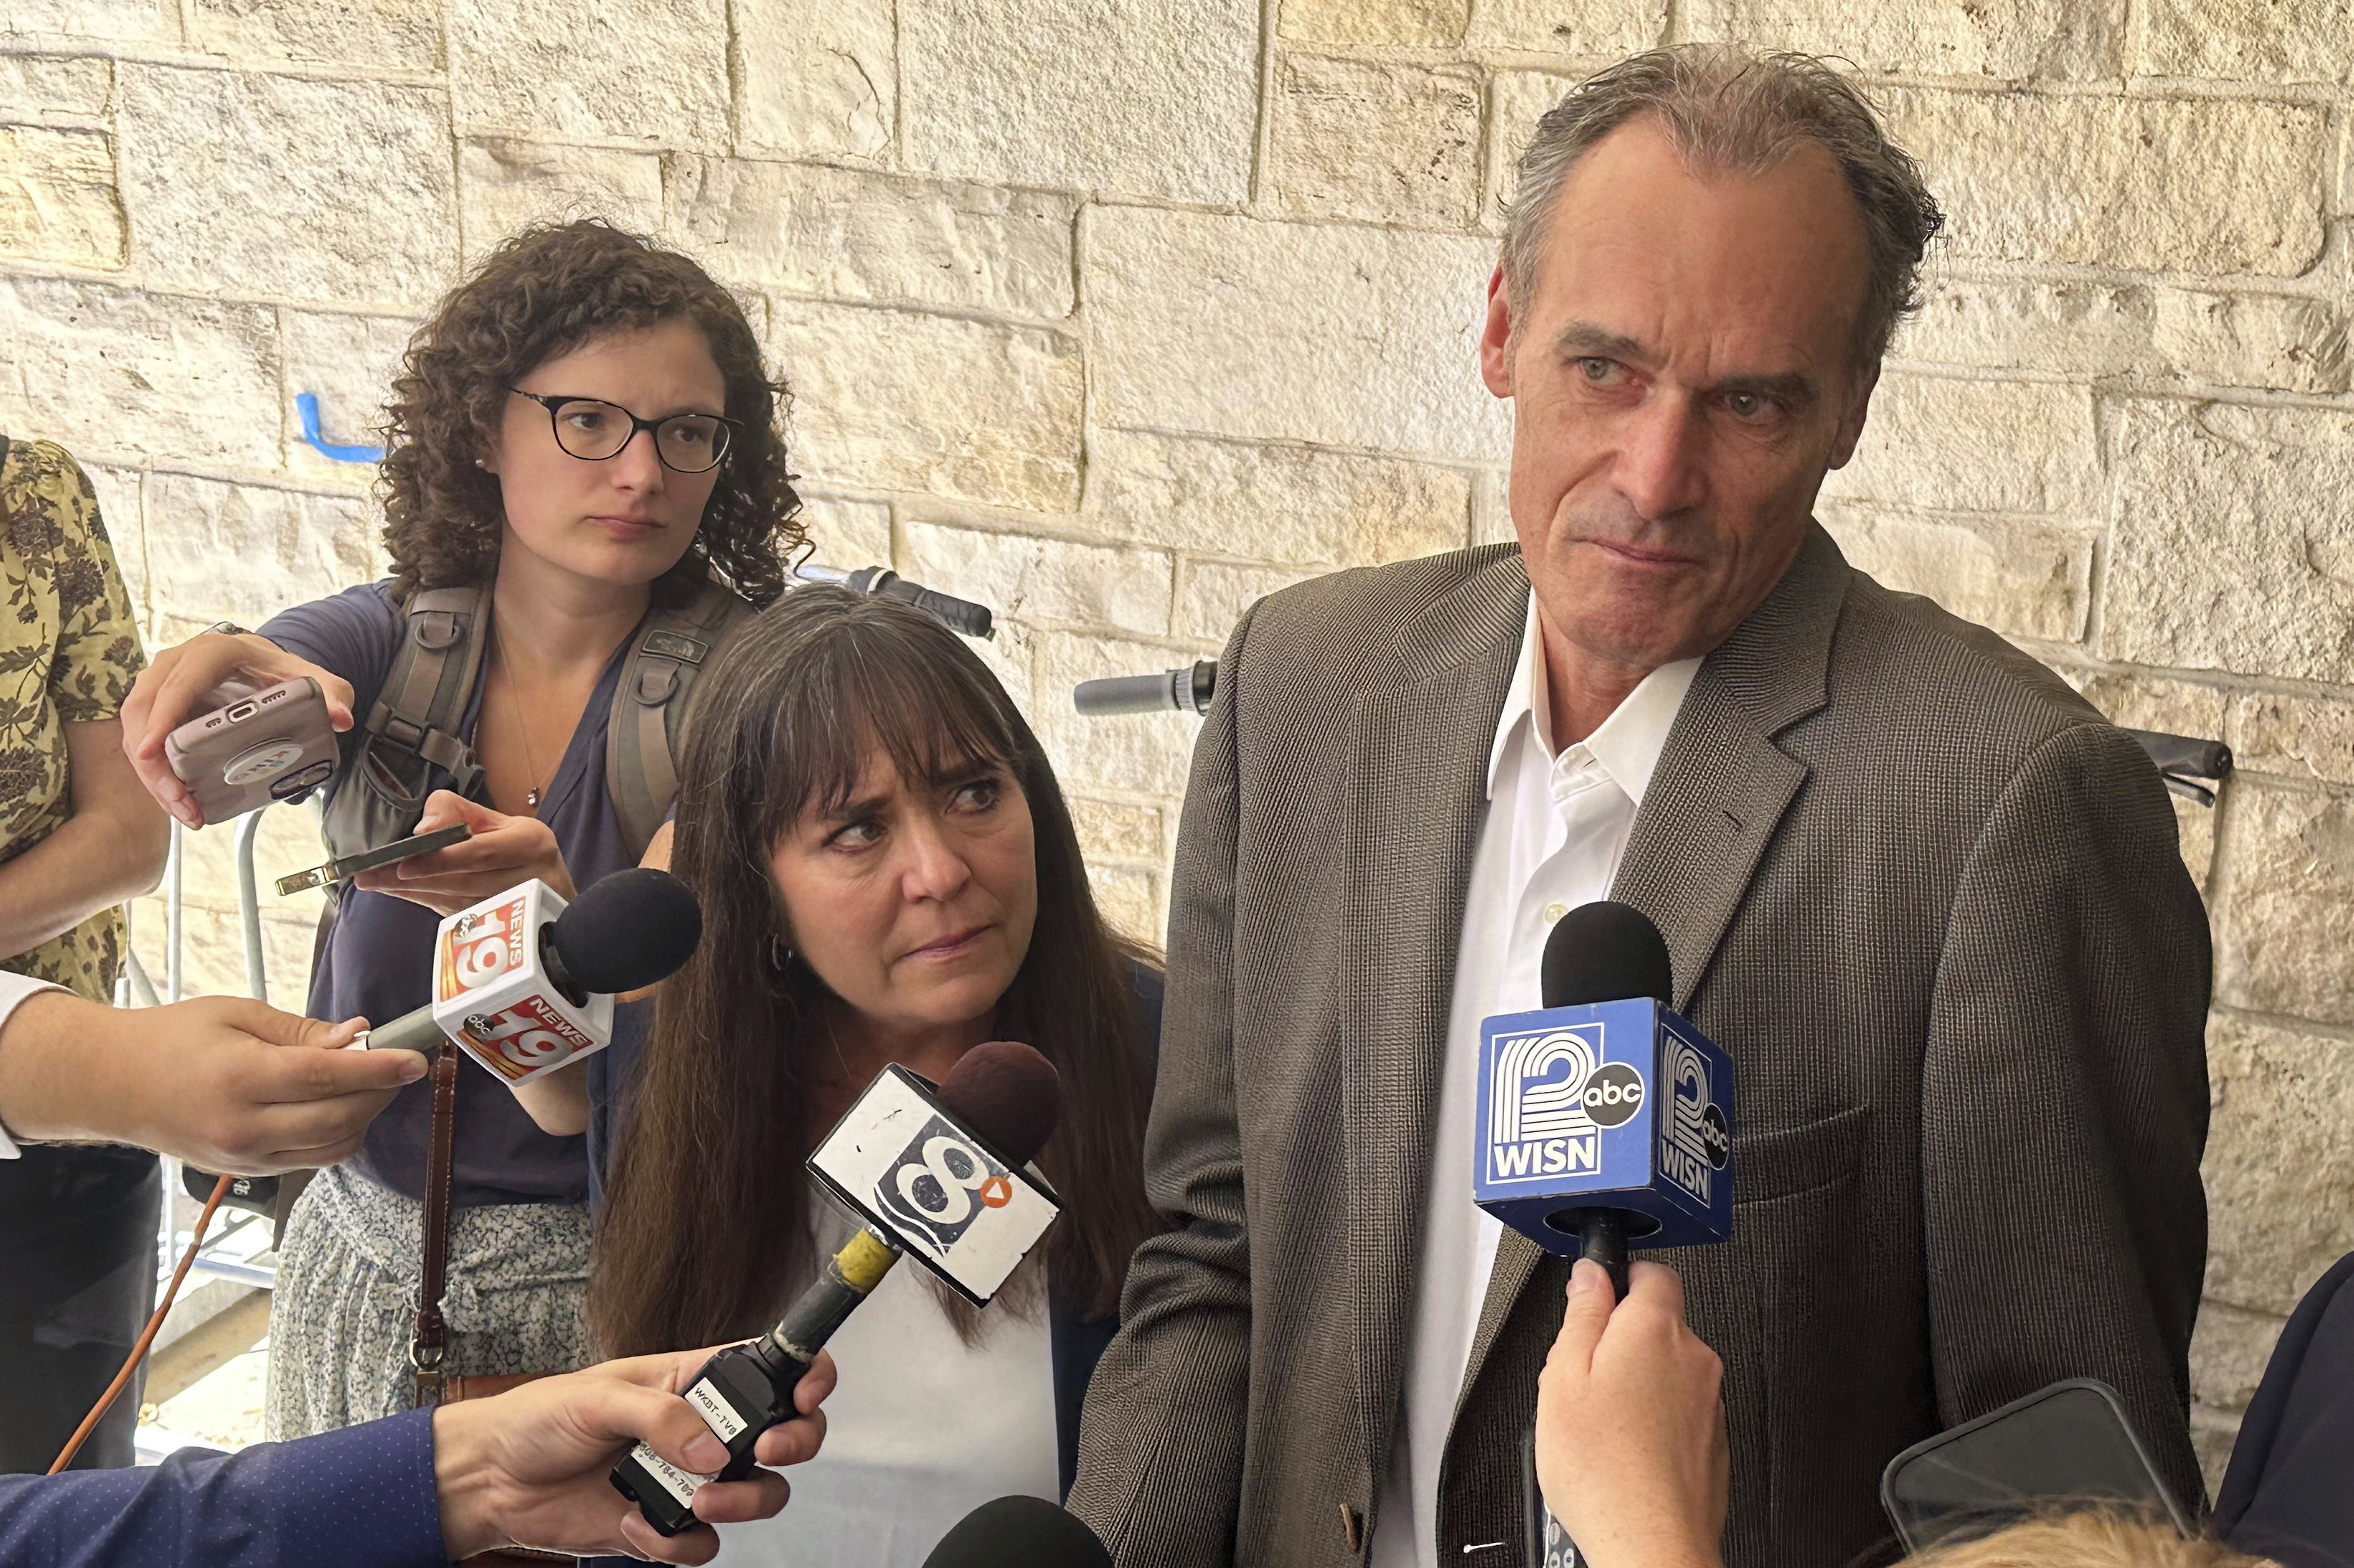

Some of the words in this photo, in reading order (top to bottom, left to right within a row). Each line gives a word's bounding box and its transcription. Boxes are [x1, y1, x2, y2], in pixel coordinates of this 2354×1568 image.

[453, 910, 508, 988] 19
[510, 900, 525, 966] NEWS
[473, 1010, 573, 1066] 19
[530, 998, 588, 1046] NEWS
[1494, 1032, 1597, 1143] 12
[1583, 1079, 1642, 1107] abc
[1494, 1137, 1595, 1177] WISN
[1703, 1119, 1728, 1152] abc
[1662, 1138, 1708, 1200] WISN
